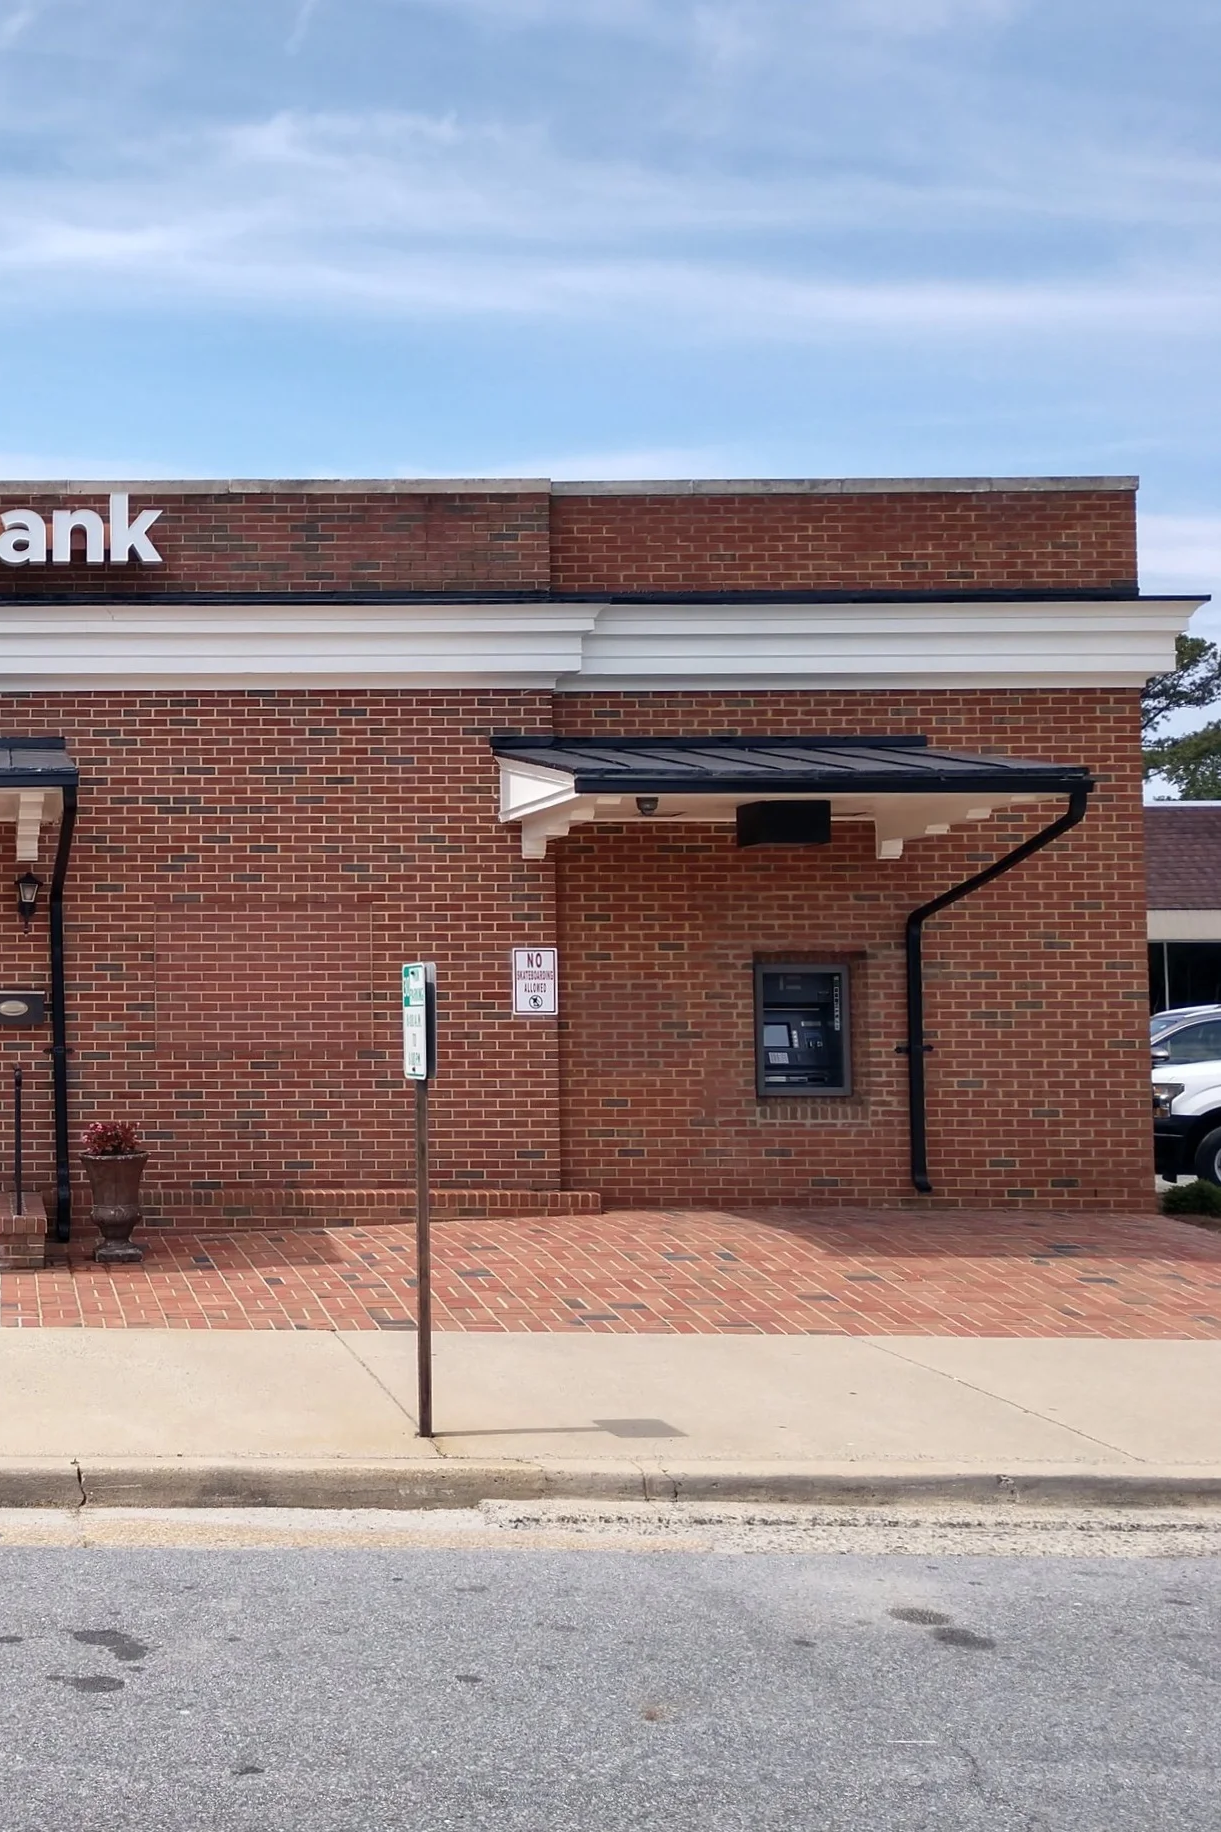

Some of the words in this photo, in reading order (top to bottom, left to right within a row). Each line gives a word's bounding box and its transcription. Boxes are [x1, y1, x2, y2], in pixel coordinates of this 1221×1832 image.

[527, 953, 542, 968] NO
[517, 970, 554, 980] SKATEBOARDING
[524, 983, 547, 993] ALLOWED
